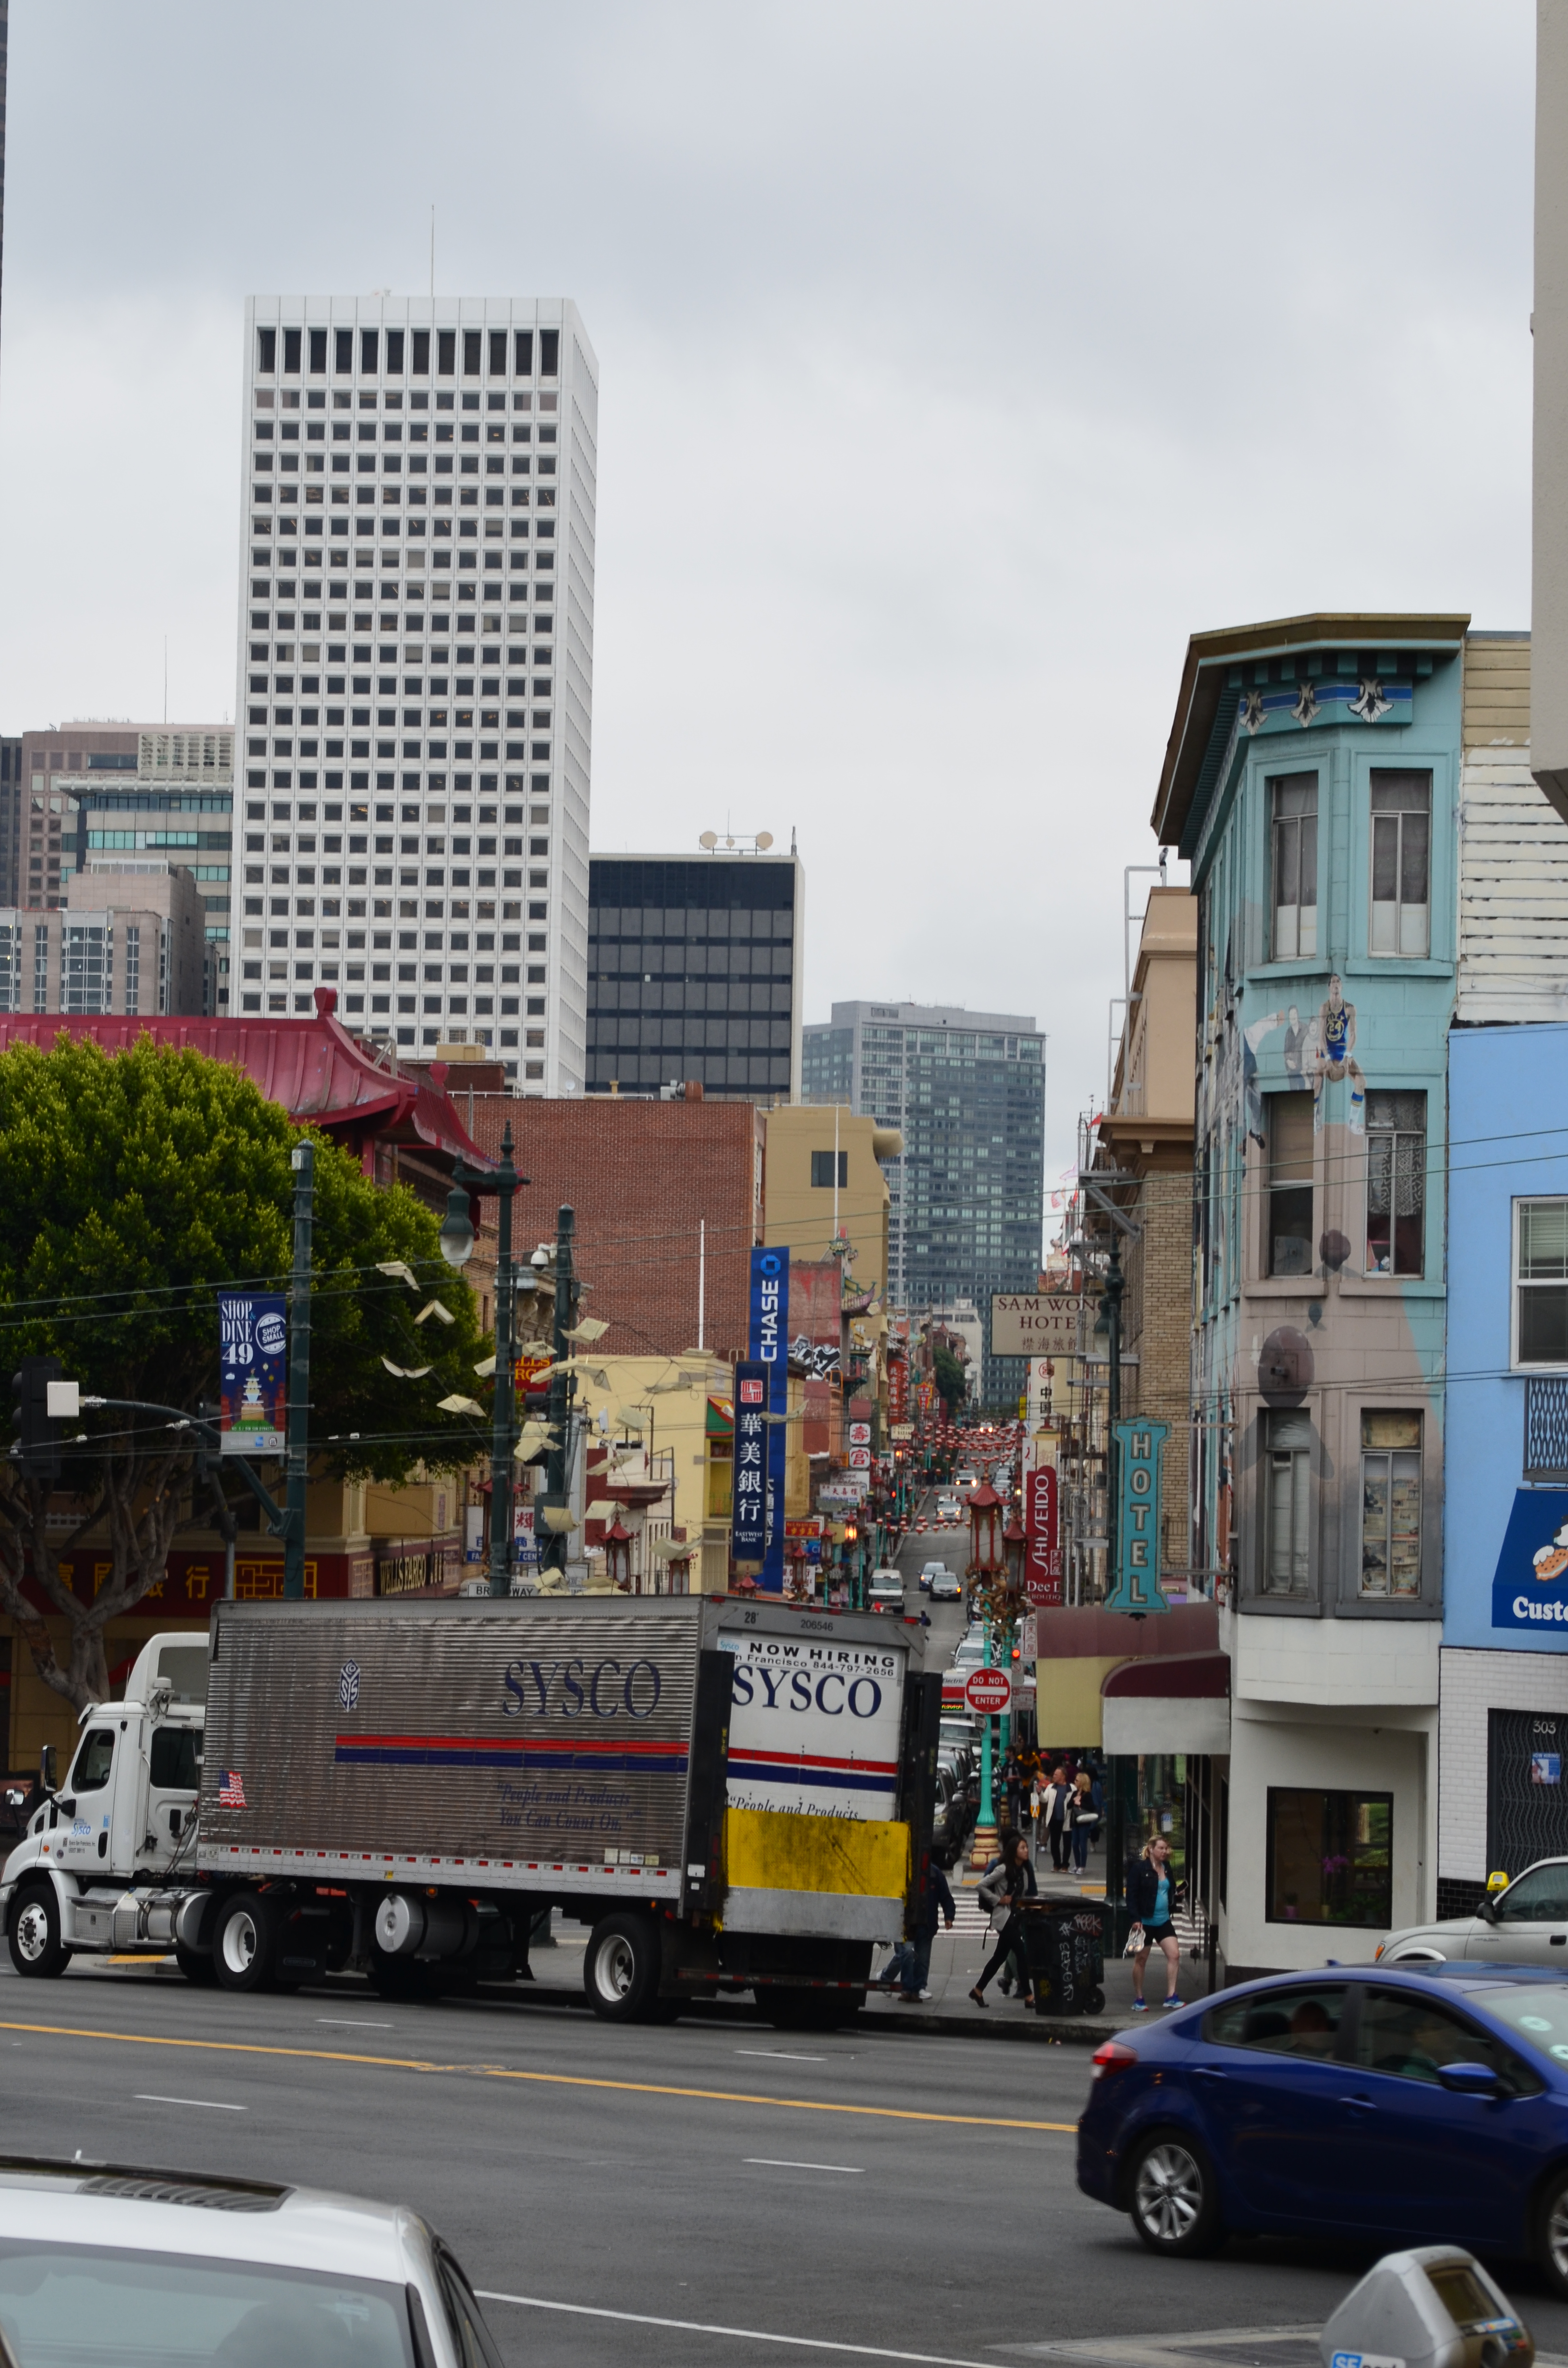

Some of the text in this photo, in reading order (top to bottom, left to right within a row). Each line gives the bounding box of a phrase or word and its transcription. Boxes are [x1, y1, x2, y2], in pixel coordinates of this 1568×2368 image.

[222, 1300, 252, 1320] SHOP
[999, 1298, 1101, 1312] SAM WON
[760, 1279, 778, 1362] CHASE
[1020, 1316, 1089, 1330] HOTE
[222, 1320, 253, 1342] DINE
[262, 1324, 281, 1336] SHOP
[262, 1331, 284, 1344] SMALL
[222, 1343, 253, 1365] 49
[738, 1413, 762, 1521] 華美銀行
[1032, 1475, 1049, 1577] SHISEIDO
[1130, 1431, 1151, 1603] HOTEL
[476, 1586, 533, 1596] BRWAY
[1027, 1580, 1051, 1592] Dee
[800, 1619, 833, 1632] 206546
[721, 1640, 739, 1651] Sysco
[750, 1642, 894, 1668] NOW HIRING
[747, 1654, 894, 1677] Francisco 844-797-2656
[502, 1661, 661, 1719] SYSCO
[989, 1677, 1004, 1685] NOT
[732, 1665, 882, 1718] SYSCO
[975, 1696, 1000, 1704] ENTER
[1533, 1720, 1556, 1734] 303
[546, 1785, 571, 1803] and
[501, 1807, 521, 1826] You
[527, 1809, 551, 1828] Can
[556, 1810, 595, 1830] Count
[779, 1801, 803, 1815] and
[807, 1803, 859, 1820] Products
[72, 1823, 91, 1838] Sysco
